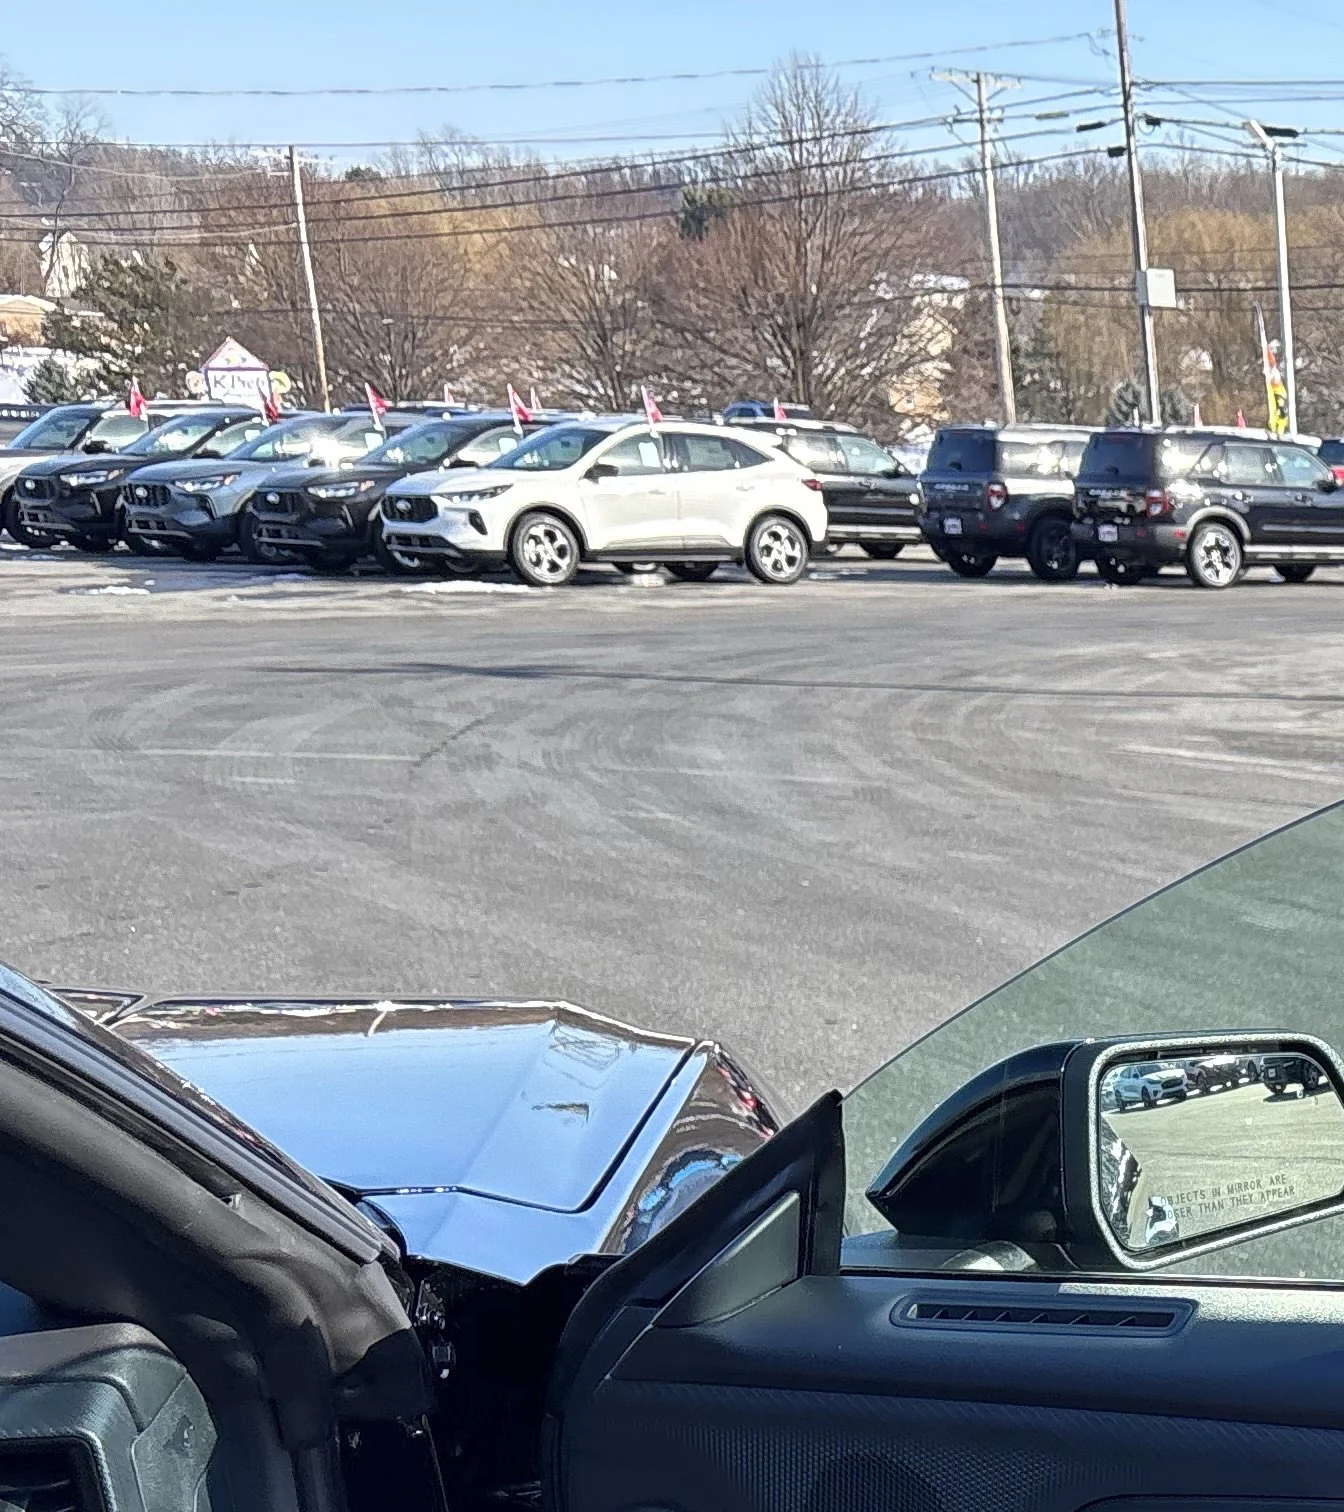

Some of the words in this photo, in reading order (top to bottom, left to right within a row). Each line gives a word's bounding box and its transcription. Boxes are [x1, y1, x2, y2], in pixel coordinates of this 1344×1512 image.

[1211, 1187, 1221, 1197] IN
[1227, 1179, 1262, 1194] MIRROR
[1269, 1174, 1287, 1185] ARE
[1167, 1207, 1192, 1219] OSER
[1199, 1200, 1224, 1214] THAN
[1230, 1193, 1254, 1206] THEY
[1261, 1186, 1295, 1201] APPEAR
